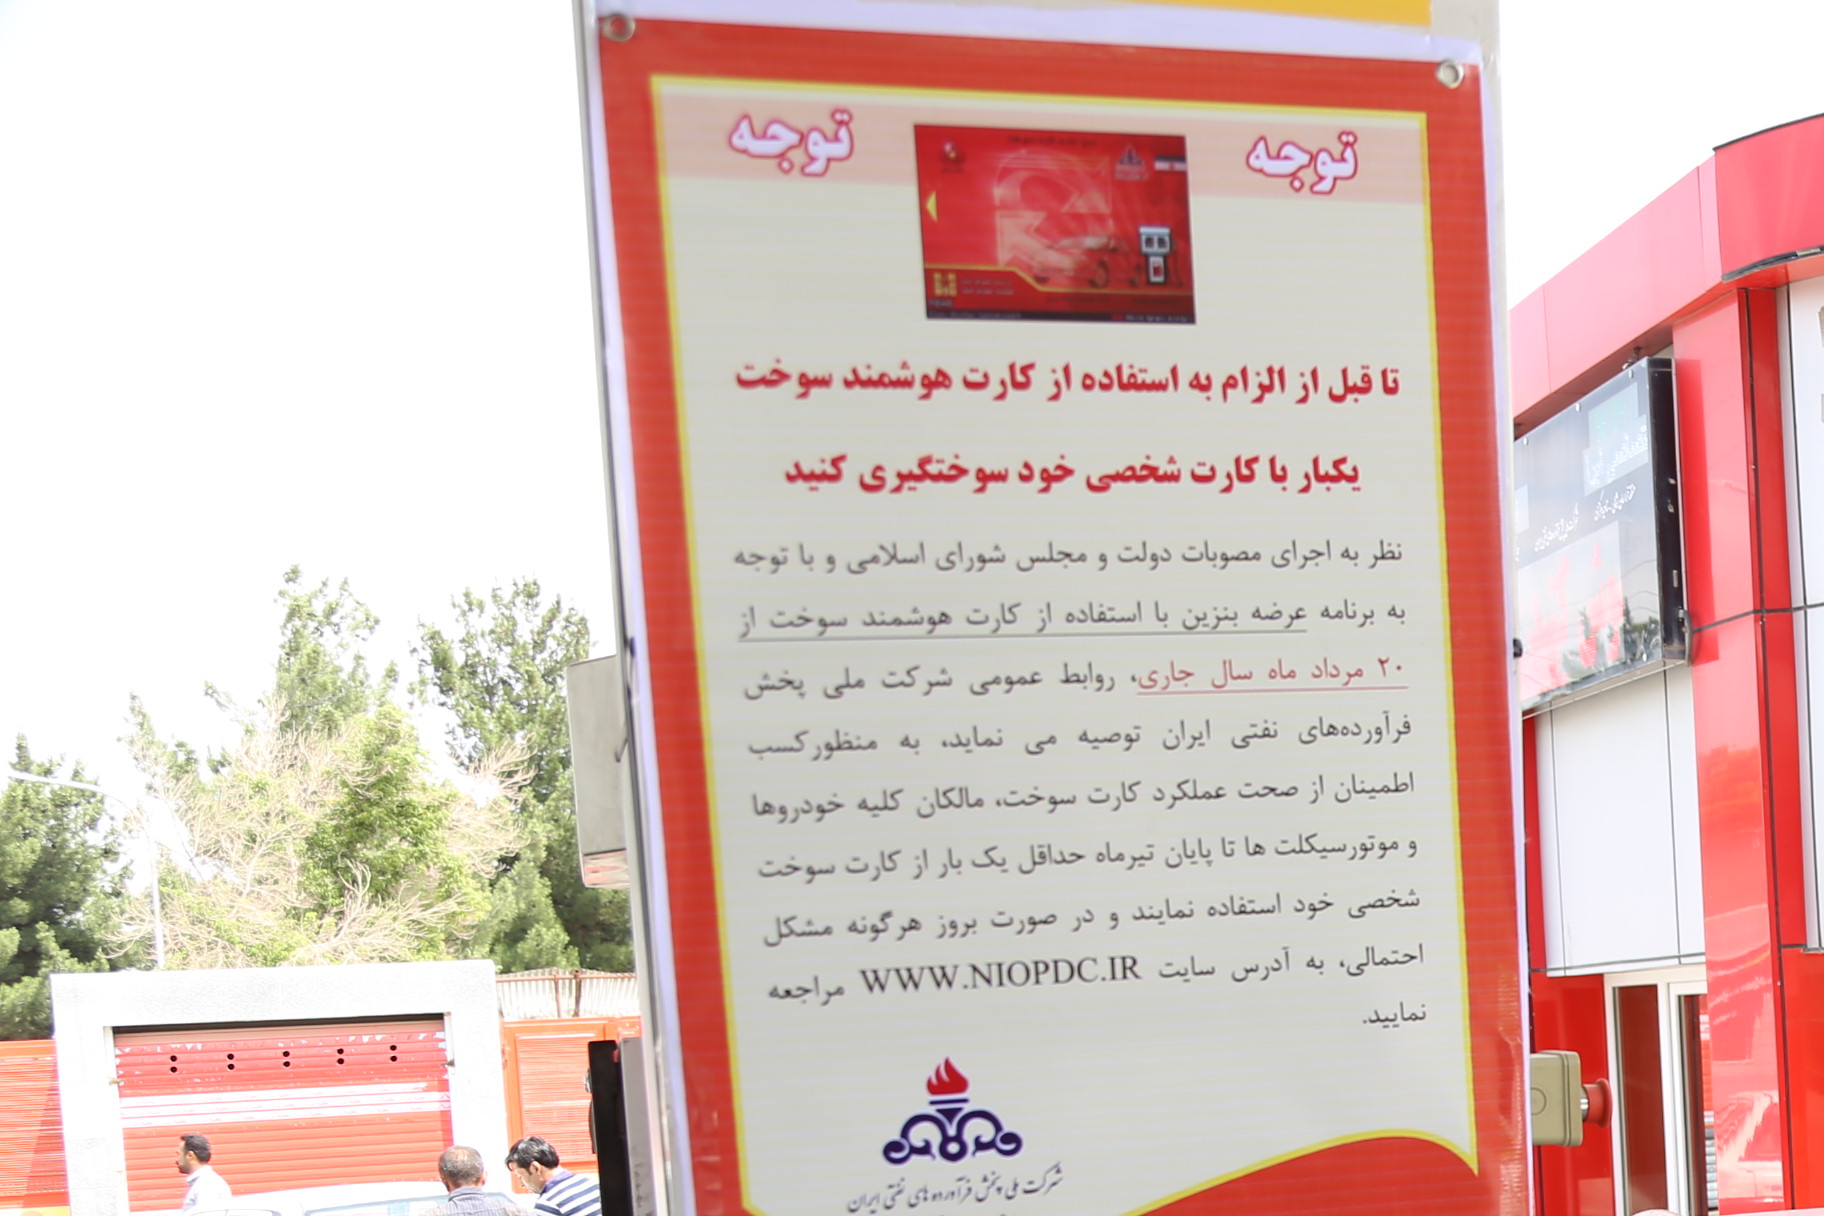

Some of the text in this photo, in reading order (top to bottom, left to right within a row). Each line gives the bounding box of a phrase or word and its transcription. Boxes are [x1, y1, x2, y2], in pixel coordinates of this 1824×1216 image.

[728, 108, 856, 177] توجه
[1245, 129, 1361, 195] توجه
[736, 356, 1400, 405] تا قبل از الزام به استفاده از کارت هوشمند سوخت
[785, 452, 1362, 495] یکبار با کارت شخصی خود سوختگیری کنید
[734, 538, 1404, 575] نظر به اجرای مصوبات دولت و مجلس شورای اسلامی و با توجه
[739, 597, 1407, 640] به برنامه عرضه بنزین با استفاده از کارت هوشمند سوخت از
[744, 672, 808, 701] پخش
[823, 666, 867, 700] ملی
[881, 664, 954, 697] شرکت
[969, 670, 1044, 697] عمومی
[1059, 660, 1116, 693] روابط
[1210, 658, 1254, 694] سال
[1267, 657, 1298, 693] ماه
[1310, 656, 1365, 692] مرداد
[1377, 656, 1404, 690] ۲۰
[899, 733, 921, 750] به
[1024, 733, 1059, 756] می
[1077, 724, 1143, 752] توصیه
[1162, 717, 1213, 751] ایران
[1230, 718, 1280, 750] نفتی
[856, 787, 905, 818] کلیه
[915, 785, 986, 819] مالکان
[1087, 779, 1143, 812] کارت
[1152, 777, 1229, 810] عملکرد
[1237, 781, 1300, 800] صحت
[1309, 773, 1325, 805] از
[1333, 770, 1416, 804] اطمینان
[751, 792, 846, 825] خودروها
[757, 831, 1419, 885] و موتورسیکلت ها تا پایان تیرماه حداقل یک بار از کارت سوخت
[1071, 907, 1096, 933] در
[1132, 897, 1196, 926] نمایند
[1207, 891, 1283, 918] استفاده
[1293, 891, 1336, 921] خود
[1347, 887, 1422, 920] شخصی
[763, 914, 835, 948] مشکل
[936, 914, 978, 940] بروز
[989, 910, 1059, 936] صورت
[1108, 910, 1121, 931] و
[859, 954, 1144, 994] WWW.NIOPDC.IR
[1158, 954, 1218, 983] سایت
[1231, 945, 1292, 983] آدرس
[1305, 955, 1326, 976] به
[767, 974, 846, 1007] مراجعه
[1362, 1000, 1428, 1029] نمایید.
